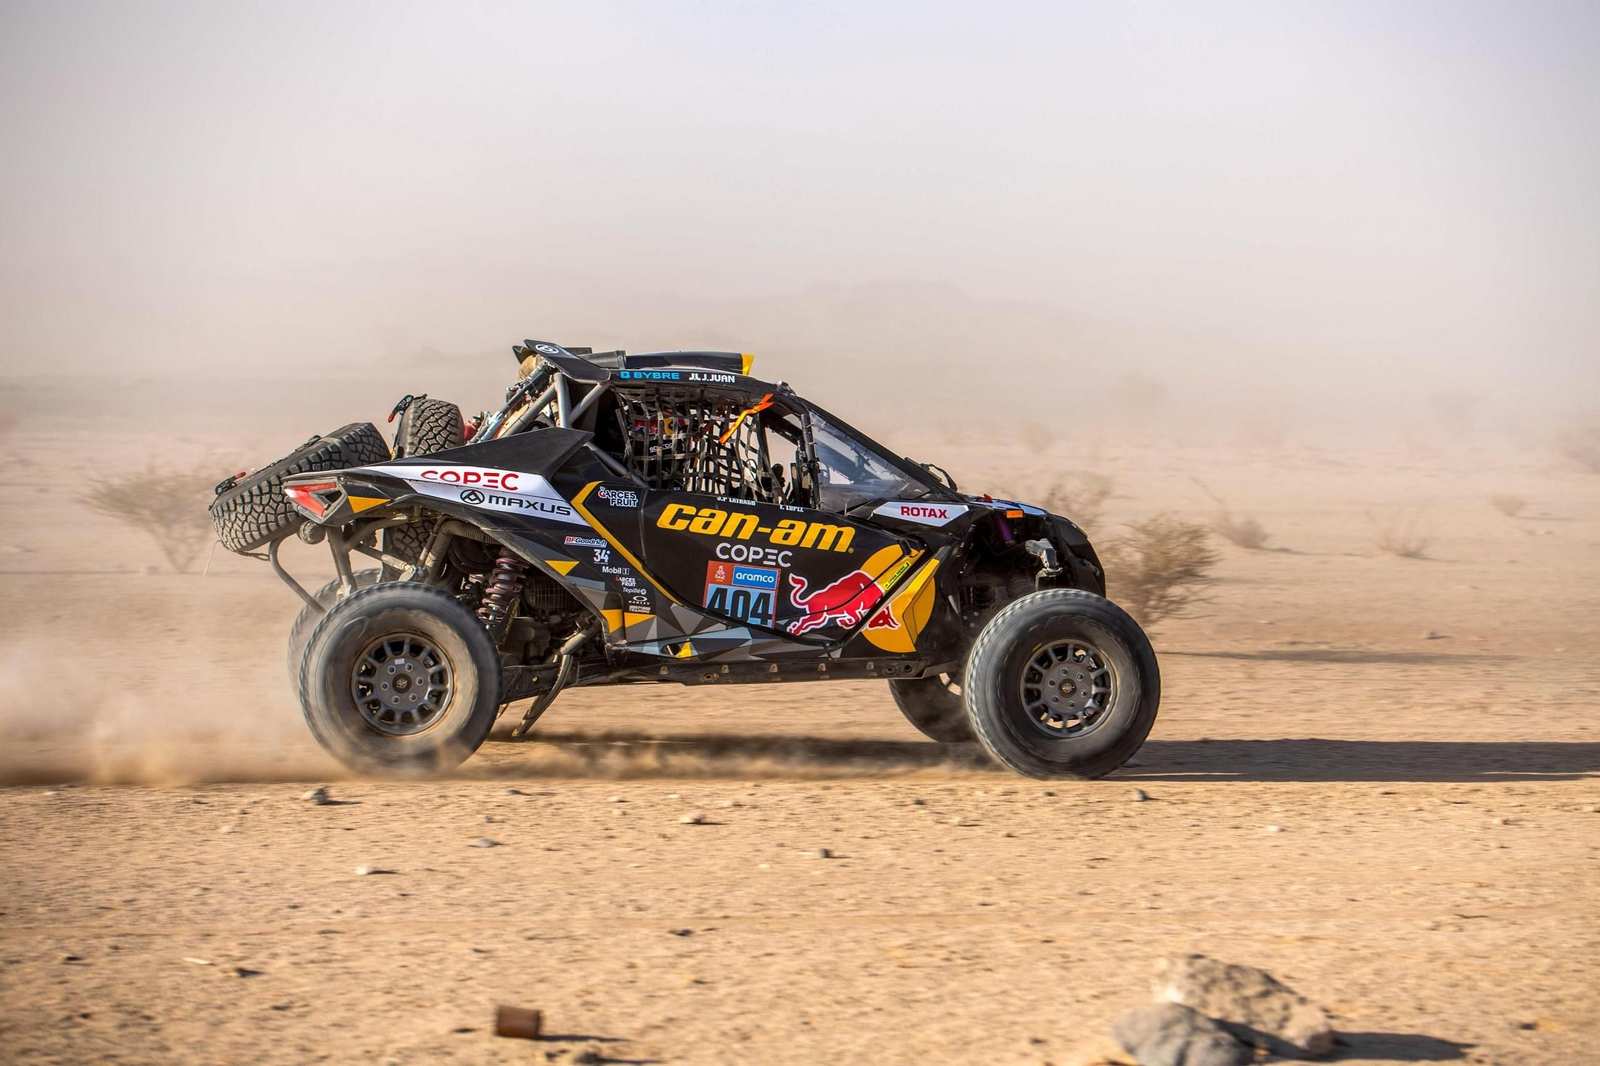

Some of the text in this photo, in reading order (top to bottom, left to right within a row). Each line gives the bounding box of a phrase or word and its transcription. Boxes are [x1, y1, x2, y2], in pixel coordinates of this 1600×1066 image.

[634, 371, 680, 380] BYBRE
[420, 470, 520, 491] COPEC
[597, 488, 636, 500] GARCES
[488, 494, 572, 516] MAXUS
[609, 498, 638, 508] FRUIT
[900, 506, 948, 519] ROTAX
[565, 536, 608, 547] BFGoodrich
[716, 542, 793, 567] COPEC
[602, 566, 622, 575] Mobil
[735, 572, 775, 583] aramco
[707, 588, 773, 625] 404
